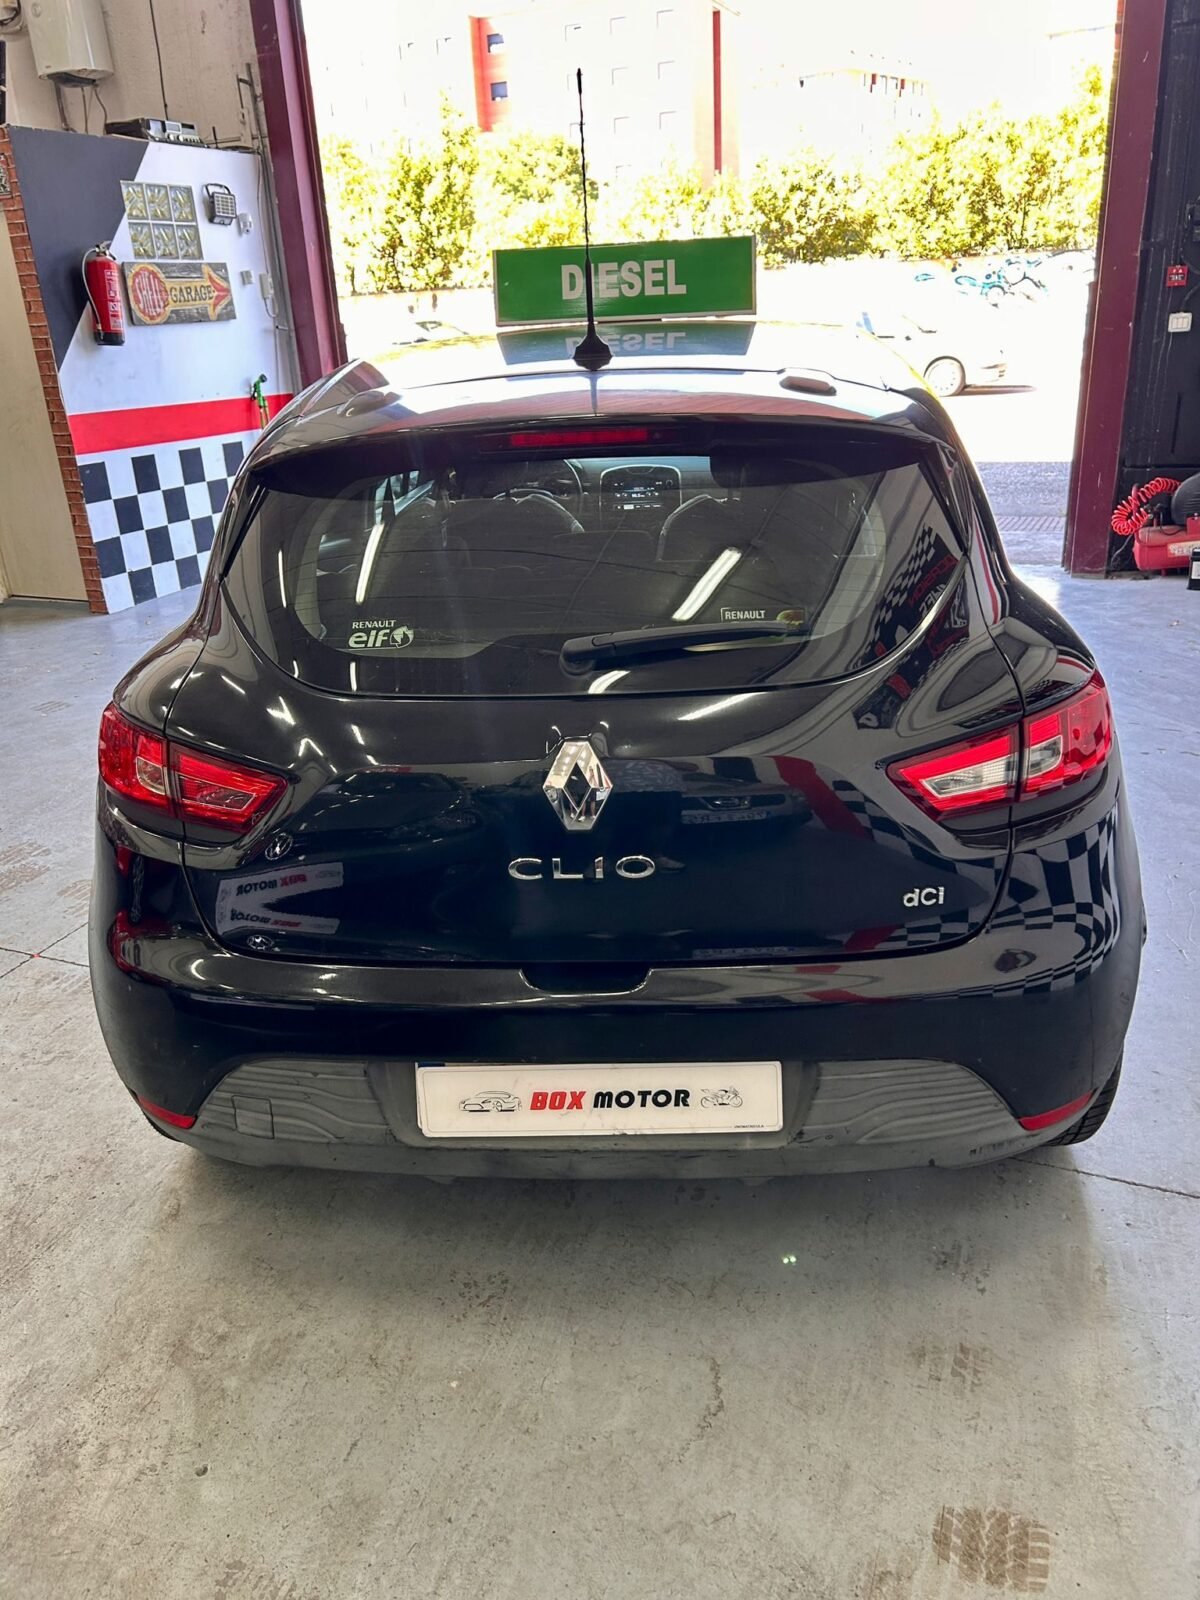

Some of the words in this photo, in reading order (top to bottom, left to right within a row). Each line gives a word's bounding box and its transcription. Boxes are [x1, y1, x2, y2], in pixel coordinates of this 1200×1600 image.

[169, 284, 214, 304] GARAGE
[352, 619, 397, 629] RENAULT
[724, 610, 766, 620] RENAULT
[348, 629, 391, 648] elf
[508, 855, 656, 881] CLIO
[530, 1090, 588, 1111] BOX
[592, 1089, 691, 1109] MOTOR
